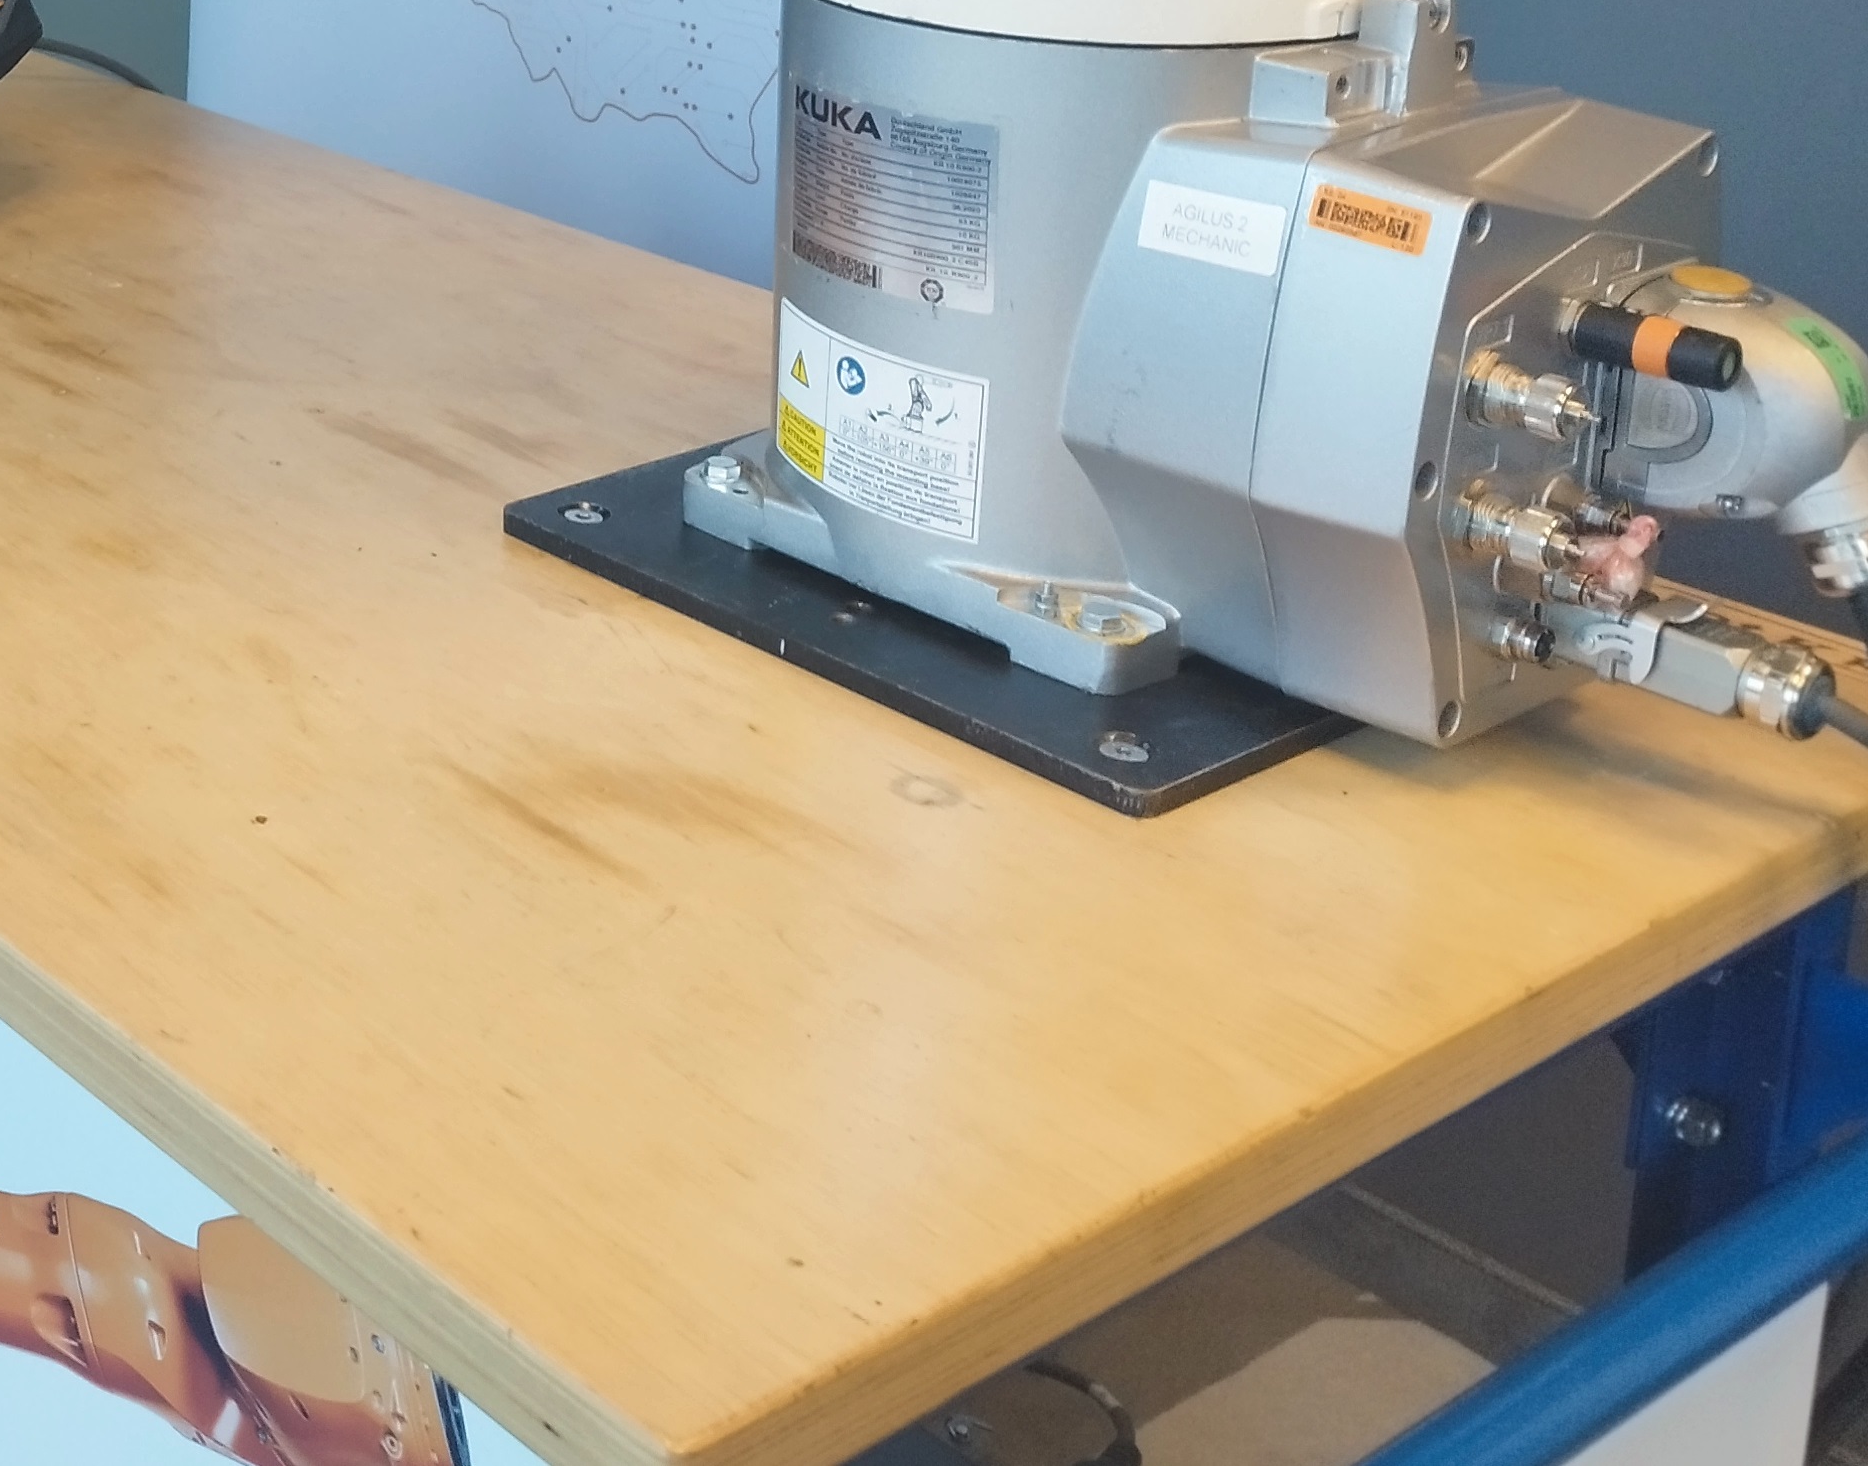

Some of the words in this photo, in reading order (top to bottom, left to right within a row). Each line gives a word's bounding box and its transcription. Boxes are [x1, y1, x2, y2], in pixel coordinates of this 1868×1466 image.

[795, 84, 882, 142] KUKA
[1172, 202, 1234, 229] AGILUS
[1237, 215, 1249, 234] 2
[1161, 223, 1252, 258] MECHANIC
[790, 409, 817, 437] CAUTION
[787, 426, 820, 457] ATTENTION
